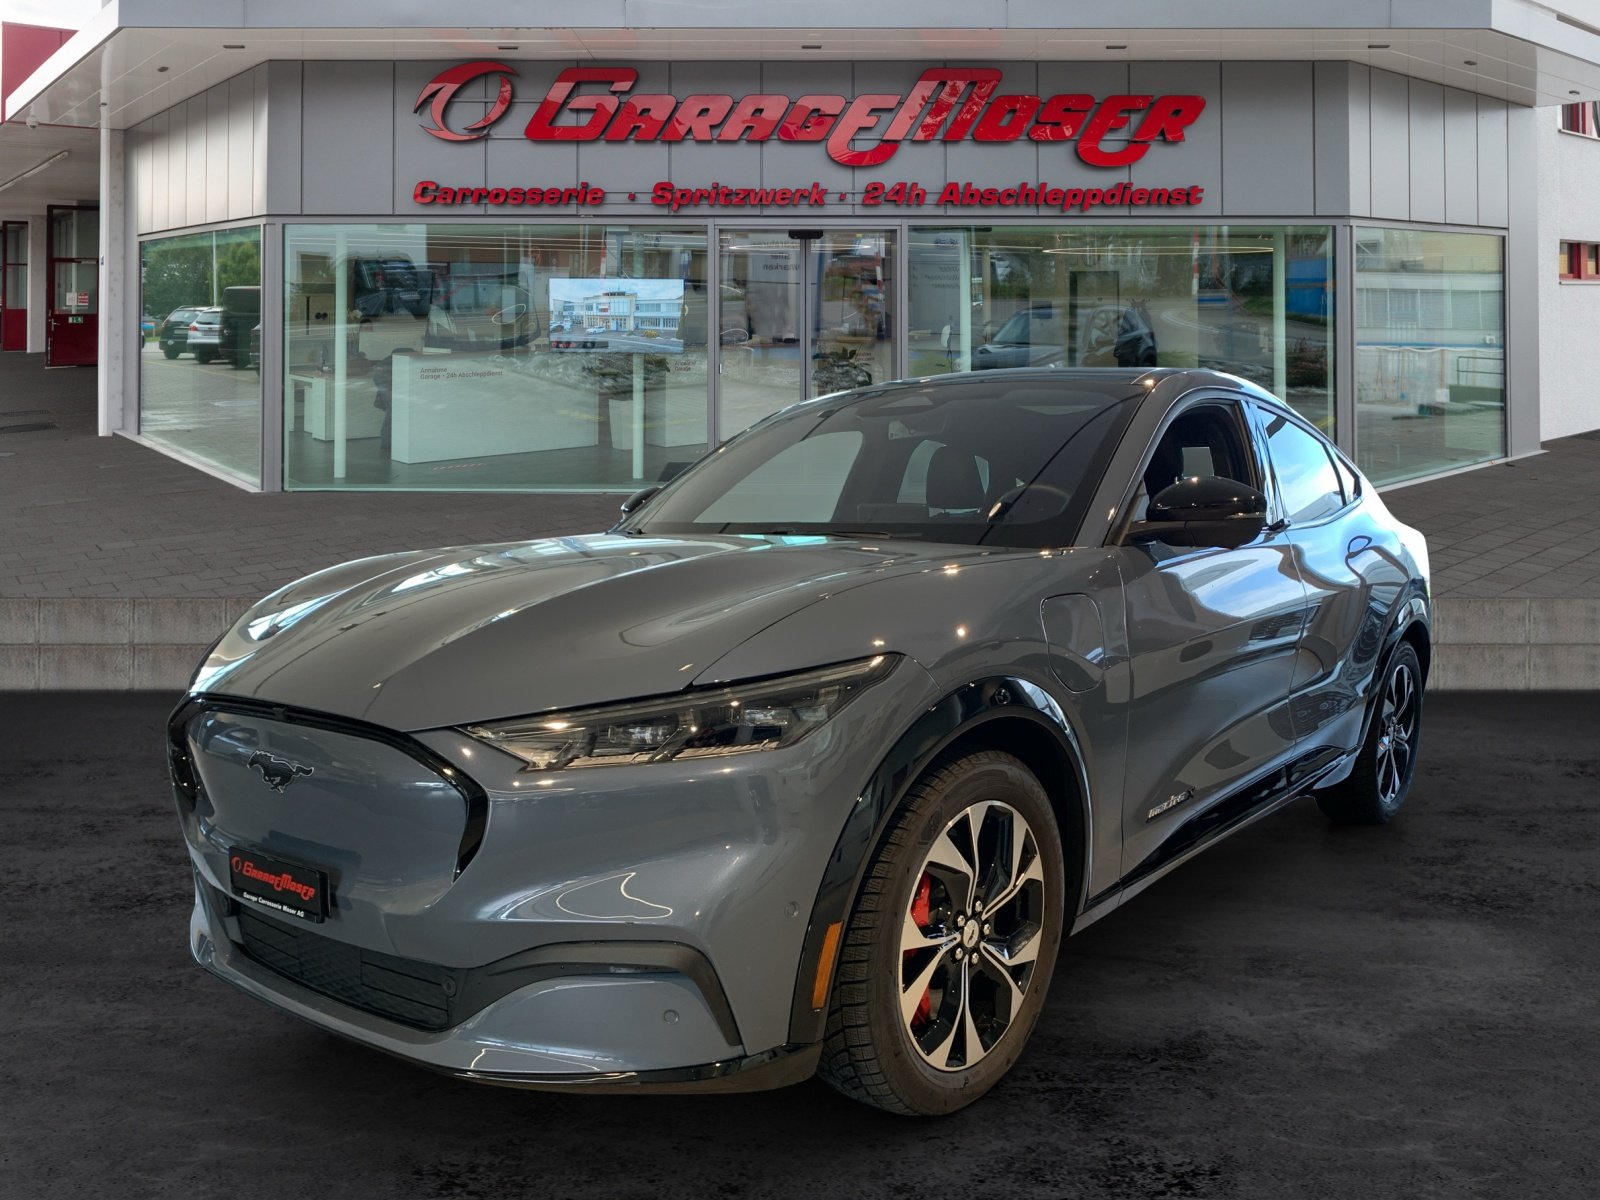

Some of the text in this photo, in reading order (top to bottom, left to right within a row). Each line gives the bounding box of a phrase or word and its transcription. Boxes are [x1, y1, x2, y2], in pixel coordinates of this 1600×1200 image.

[413, 181, 1204, 211] Carrosserie Spritzwerk 24h Abschleppdienst
[458, 371, 503, 379] Abschleppdienst
[243, 891, 305, 918] Garage Carrosserie Moser AG
